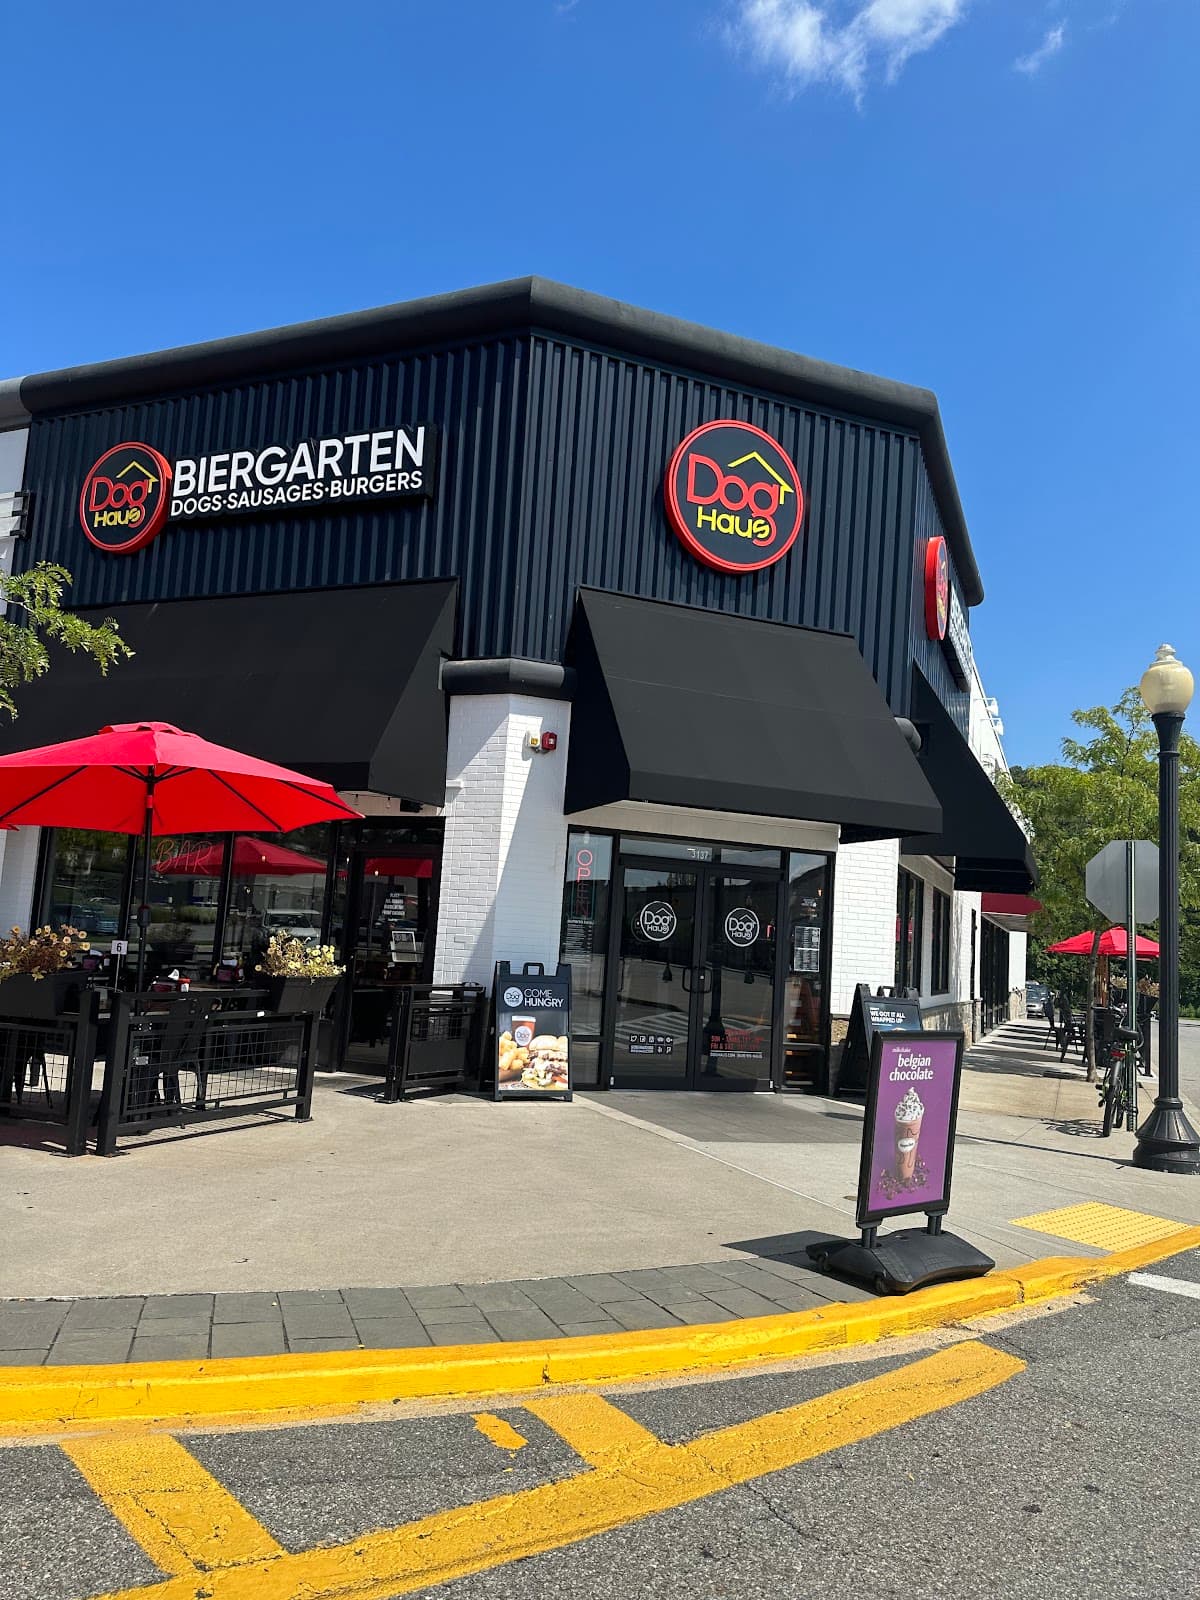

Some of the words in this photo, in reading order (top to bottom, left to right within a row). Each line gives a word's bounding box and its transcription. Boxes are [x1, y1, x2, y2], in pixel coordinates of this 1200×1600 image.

[172, 426, 425, 498] BIERGARTEN
[89, 476, 146, 528] Dog
[687, 453, 779, 547] Dog
[93, 507, 141, 528] Haus
[696, 506, 770, 539] Haus
[154, 839, 213, 875] BAR
[644, 911, 670, 934] Dog
[647, 925, 669, 934] Haus
[729, 917, 754, 940] Dog
[731, 931, 752, 940] Haus
[116, 942, 122, 953] 6
[524, 988, 552, 998] COME
[524, 997, 564, 1007] HUNGRY
[898, 1053, 931, 1070] belgian
[889, 1066, 934, 1081] chocolate
